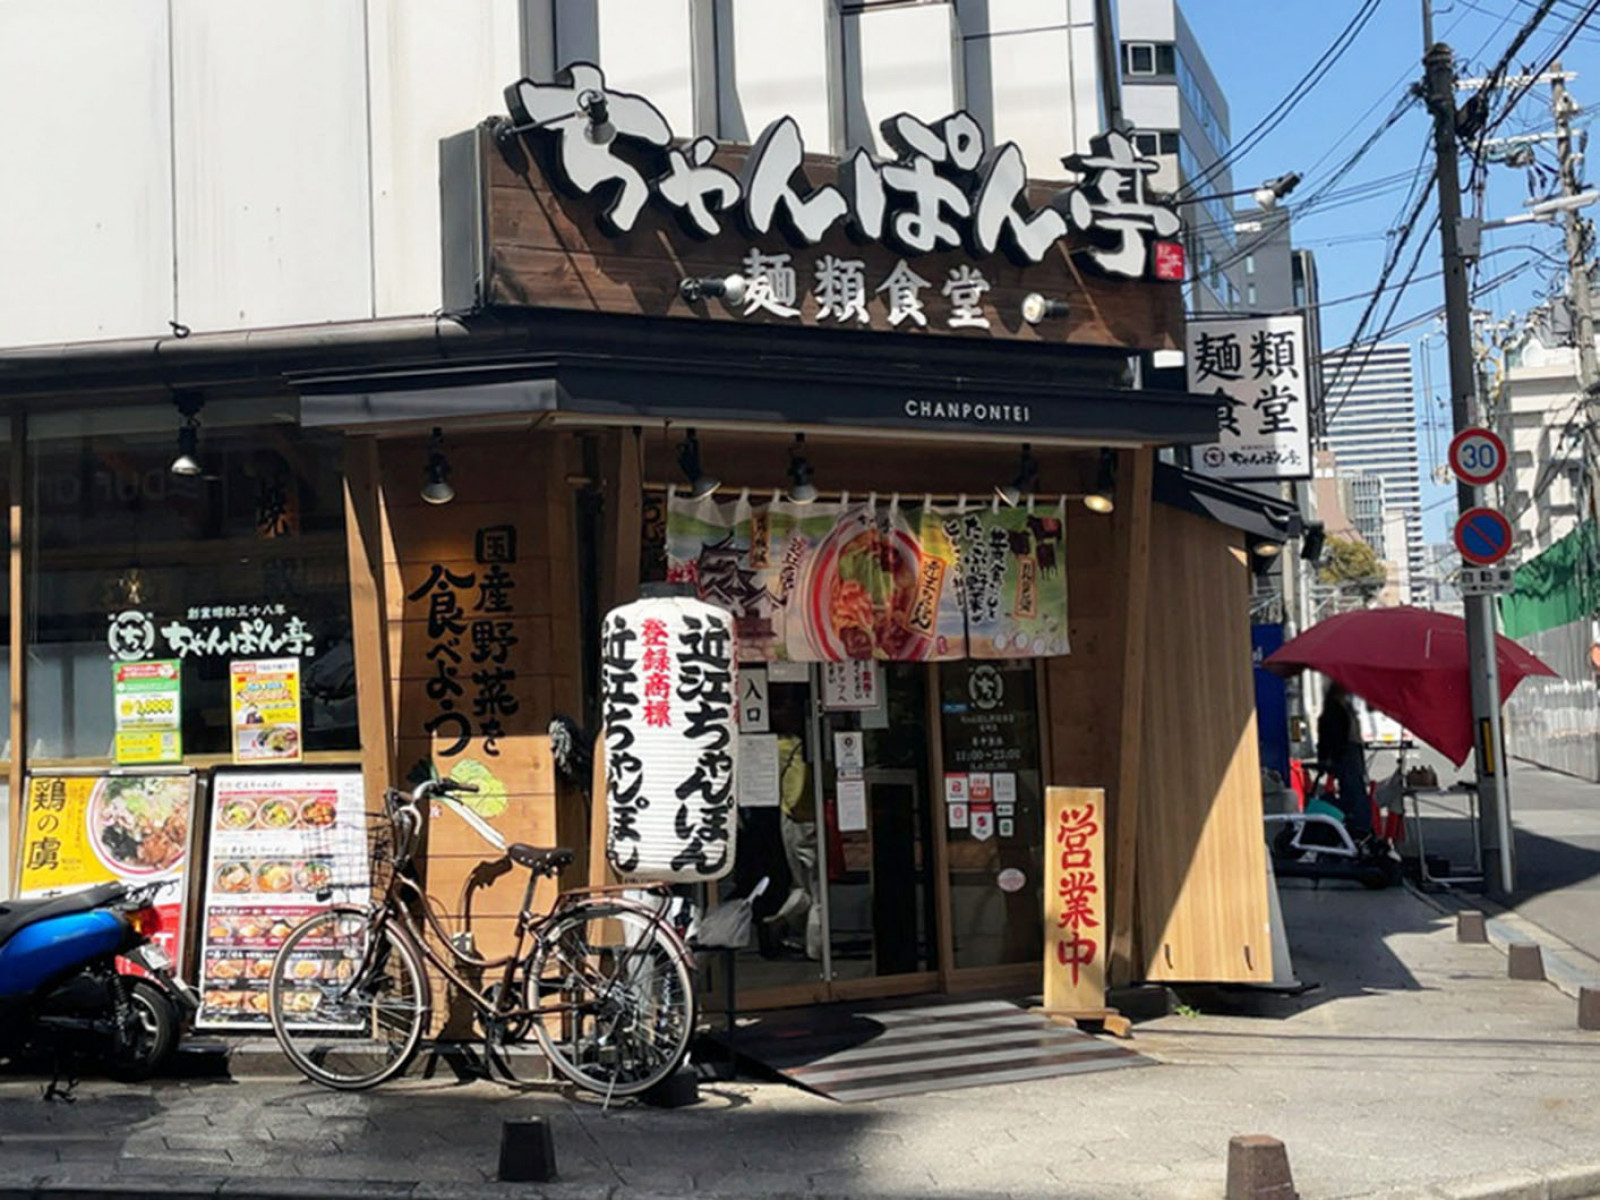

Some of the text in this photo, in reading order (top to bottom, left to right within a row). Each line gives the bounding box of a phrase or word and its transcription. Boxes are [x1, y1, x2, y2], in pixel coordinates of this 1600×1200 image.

[506, 62, 1181, 278] ちゃんぽん亭
[743, 249, 991, 330] 麺類食堂
[1194, 330, 1299, 383] 麺類
[905, 400, 1030, 422] CHANPONTEI
[1461, 443, 1494, 470] 30
[160, 616, 314, 657] ちゃんぽん亭
[408, 564, 474, 756] 食べよう
[471, 525, 518, 756] 国産野菜を
[641, 617, 672, 728] 登録商標
[671, 614, 735, 874] 近江ちゃんぽん
[744, 679, 762, 723] 入口
[26, 777, 67, 870] 鶏の虜
[1057, 804, 1099, 988] 営業中
